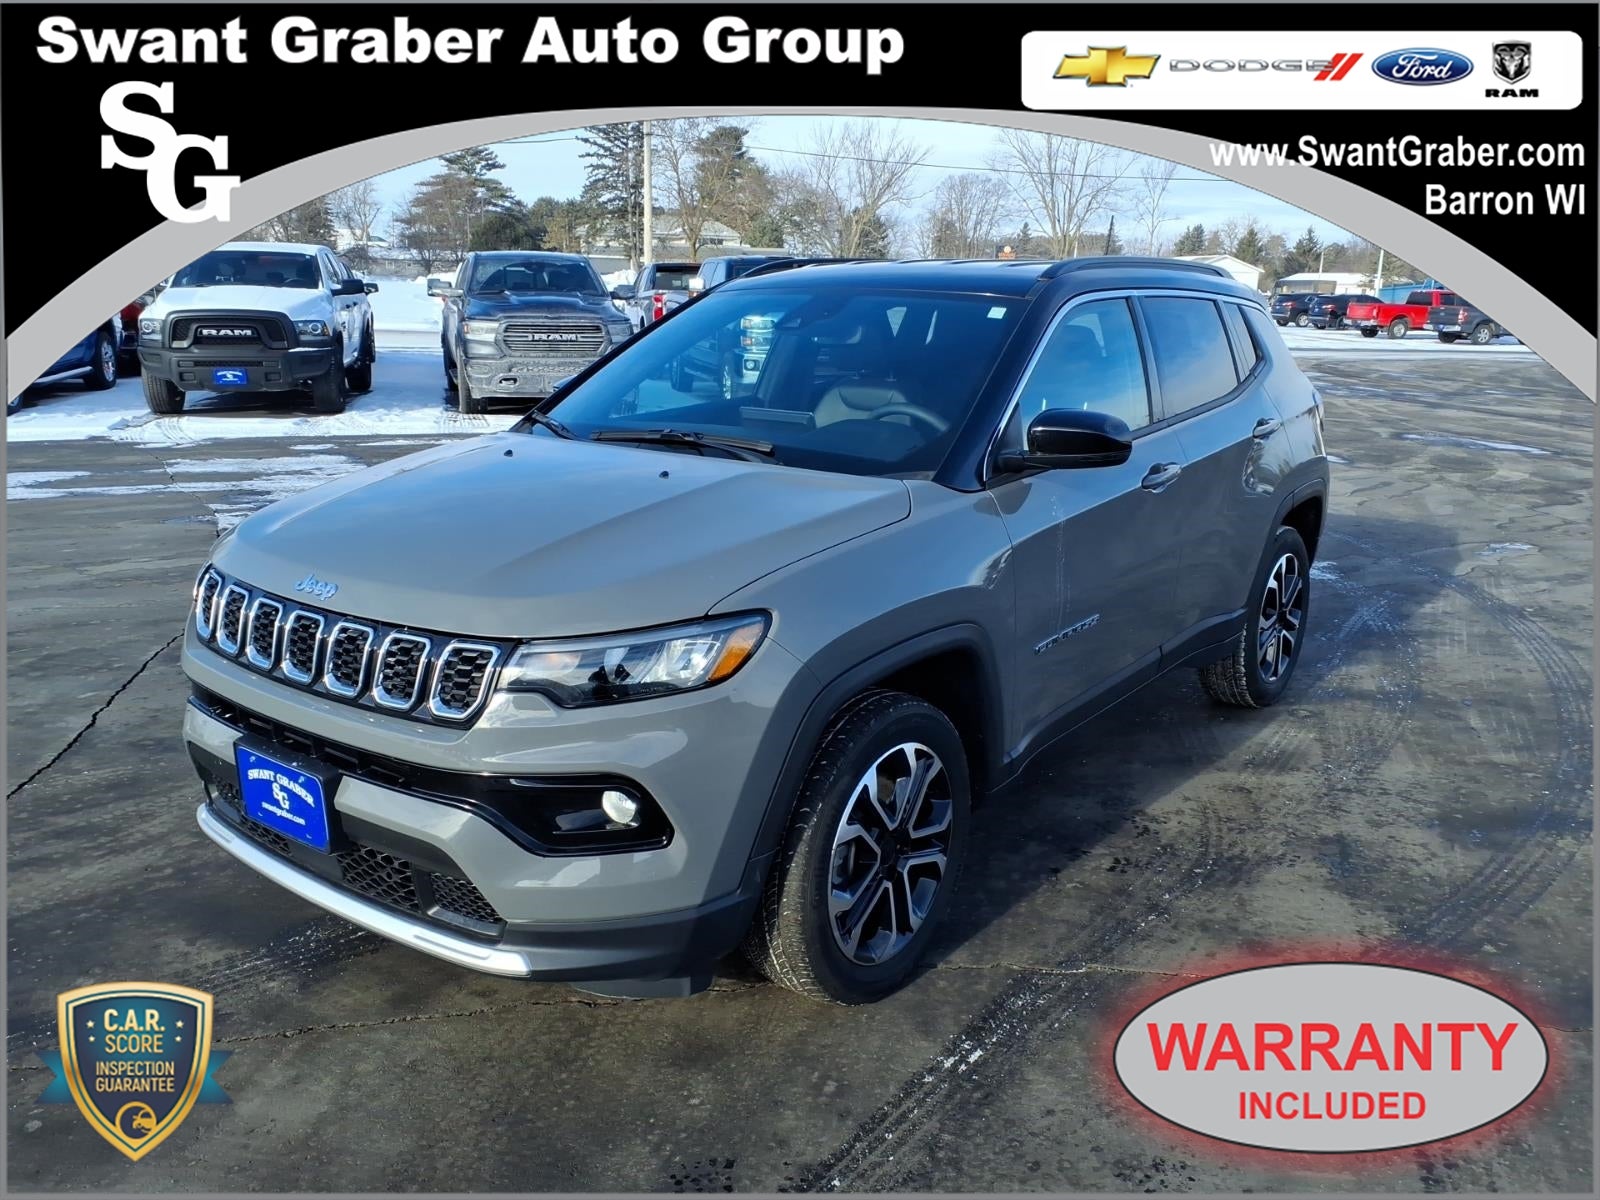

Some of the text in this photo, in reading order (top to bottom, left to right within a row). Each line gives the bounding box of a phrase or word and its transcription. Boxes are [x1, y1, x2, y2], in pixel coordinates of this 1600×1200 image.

[533, 333, 577, 341] RAM
[295, 574, 338, 601] Jeep
[247, 768, 315, 808] SWANT GRABER
